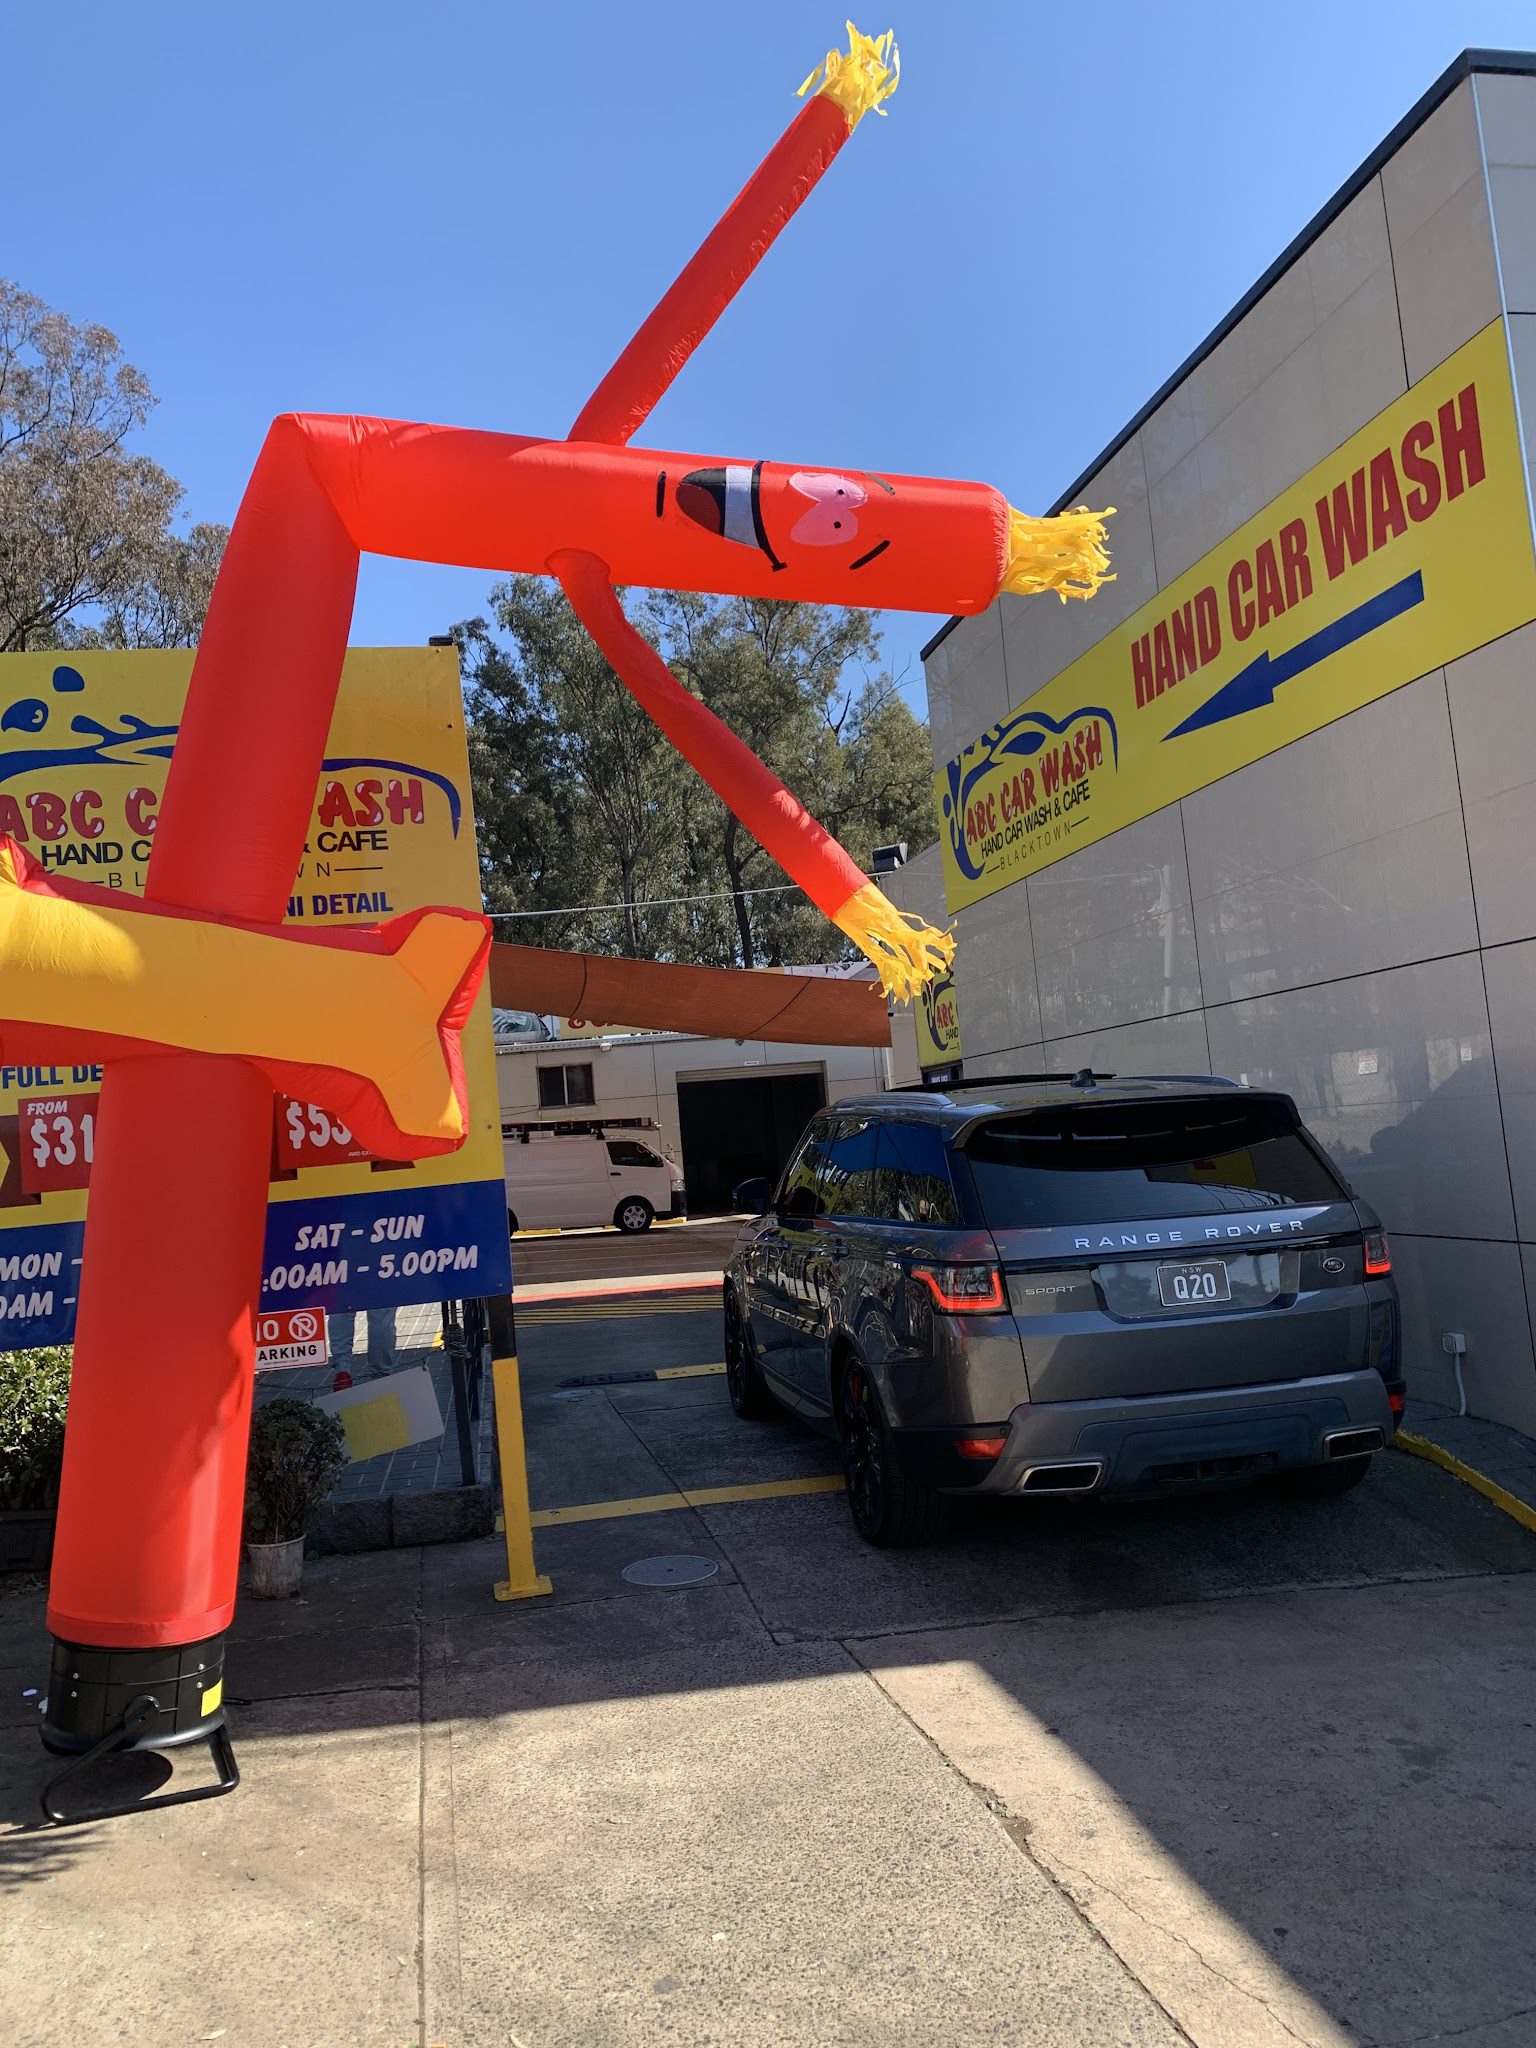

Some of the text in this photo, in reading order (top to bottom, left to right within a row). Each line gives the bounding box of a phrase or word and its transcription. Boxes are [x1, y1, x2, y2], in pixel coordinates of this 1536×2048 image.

[1131, 382, 1486, 710] HAND CAR WASH
[966, 720, 1103, 846] ABC CAR WASH
[0, 790, 105, 842] ABC
[317, 778, 425, 828] ASH
[981, 778, 1091, 860] HAND CAR WASH & CAFE
[41, 841, 124, 867] HAND
[317, 830, 389, 854] CAFE
[1000, 821, 1072, 870] BLACKTOWN
[284, 891, 394, 918] NI DETAIL
[936, 1001, 955, 1030] ABC
[2, 1065, 64, 1090] FULL
[27, 1100, 68, 1116] FROM
[295, 1223, 346, 1251] SAT
[370, 1214, 425, 1243] SUN
[1074, 1220, 1305, 1249] RANGE ROVER
[0, 1251, 63, 1282] MON
[262, 1259, 349, 1292] :00AM
[378, 1245, 478, 1279] 5.00PM
[1181, 1266, 1202, 1274] NSW
[1025, 1285, 1077, 1296] SPORT
[1173, 1272, 1217, 1300] Q20
[258, 1344, 317, 1362] ARKING
